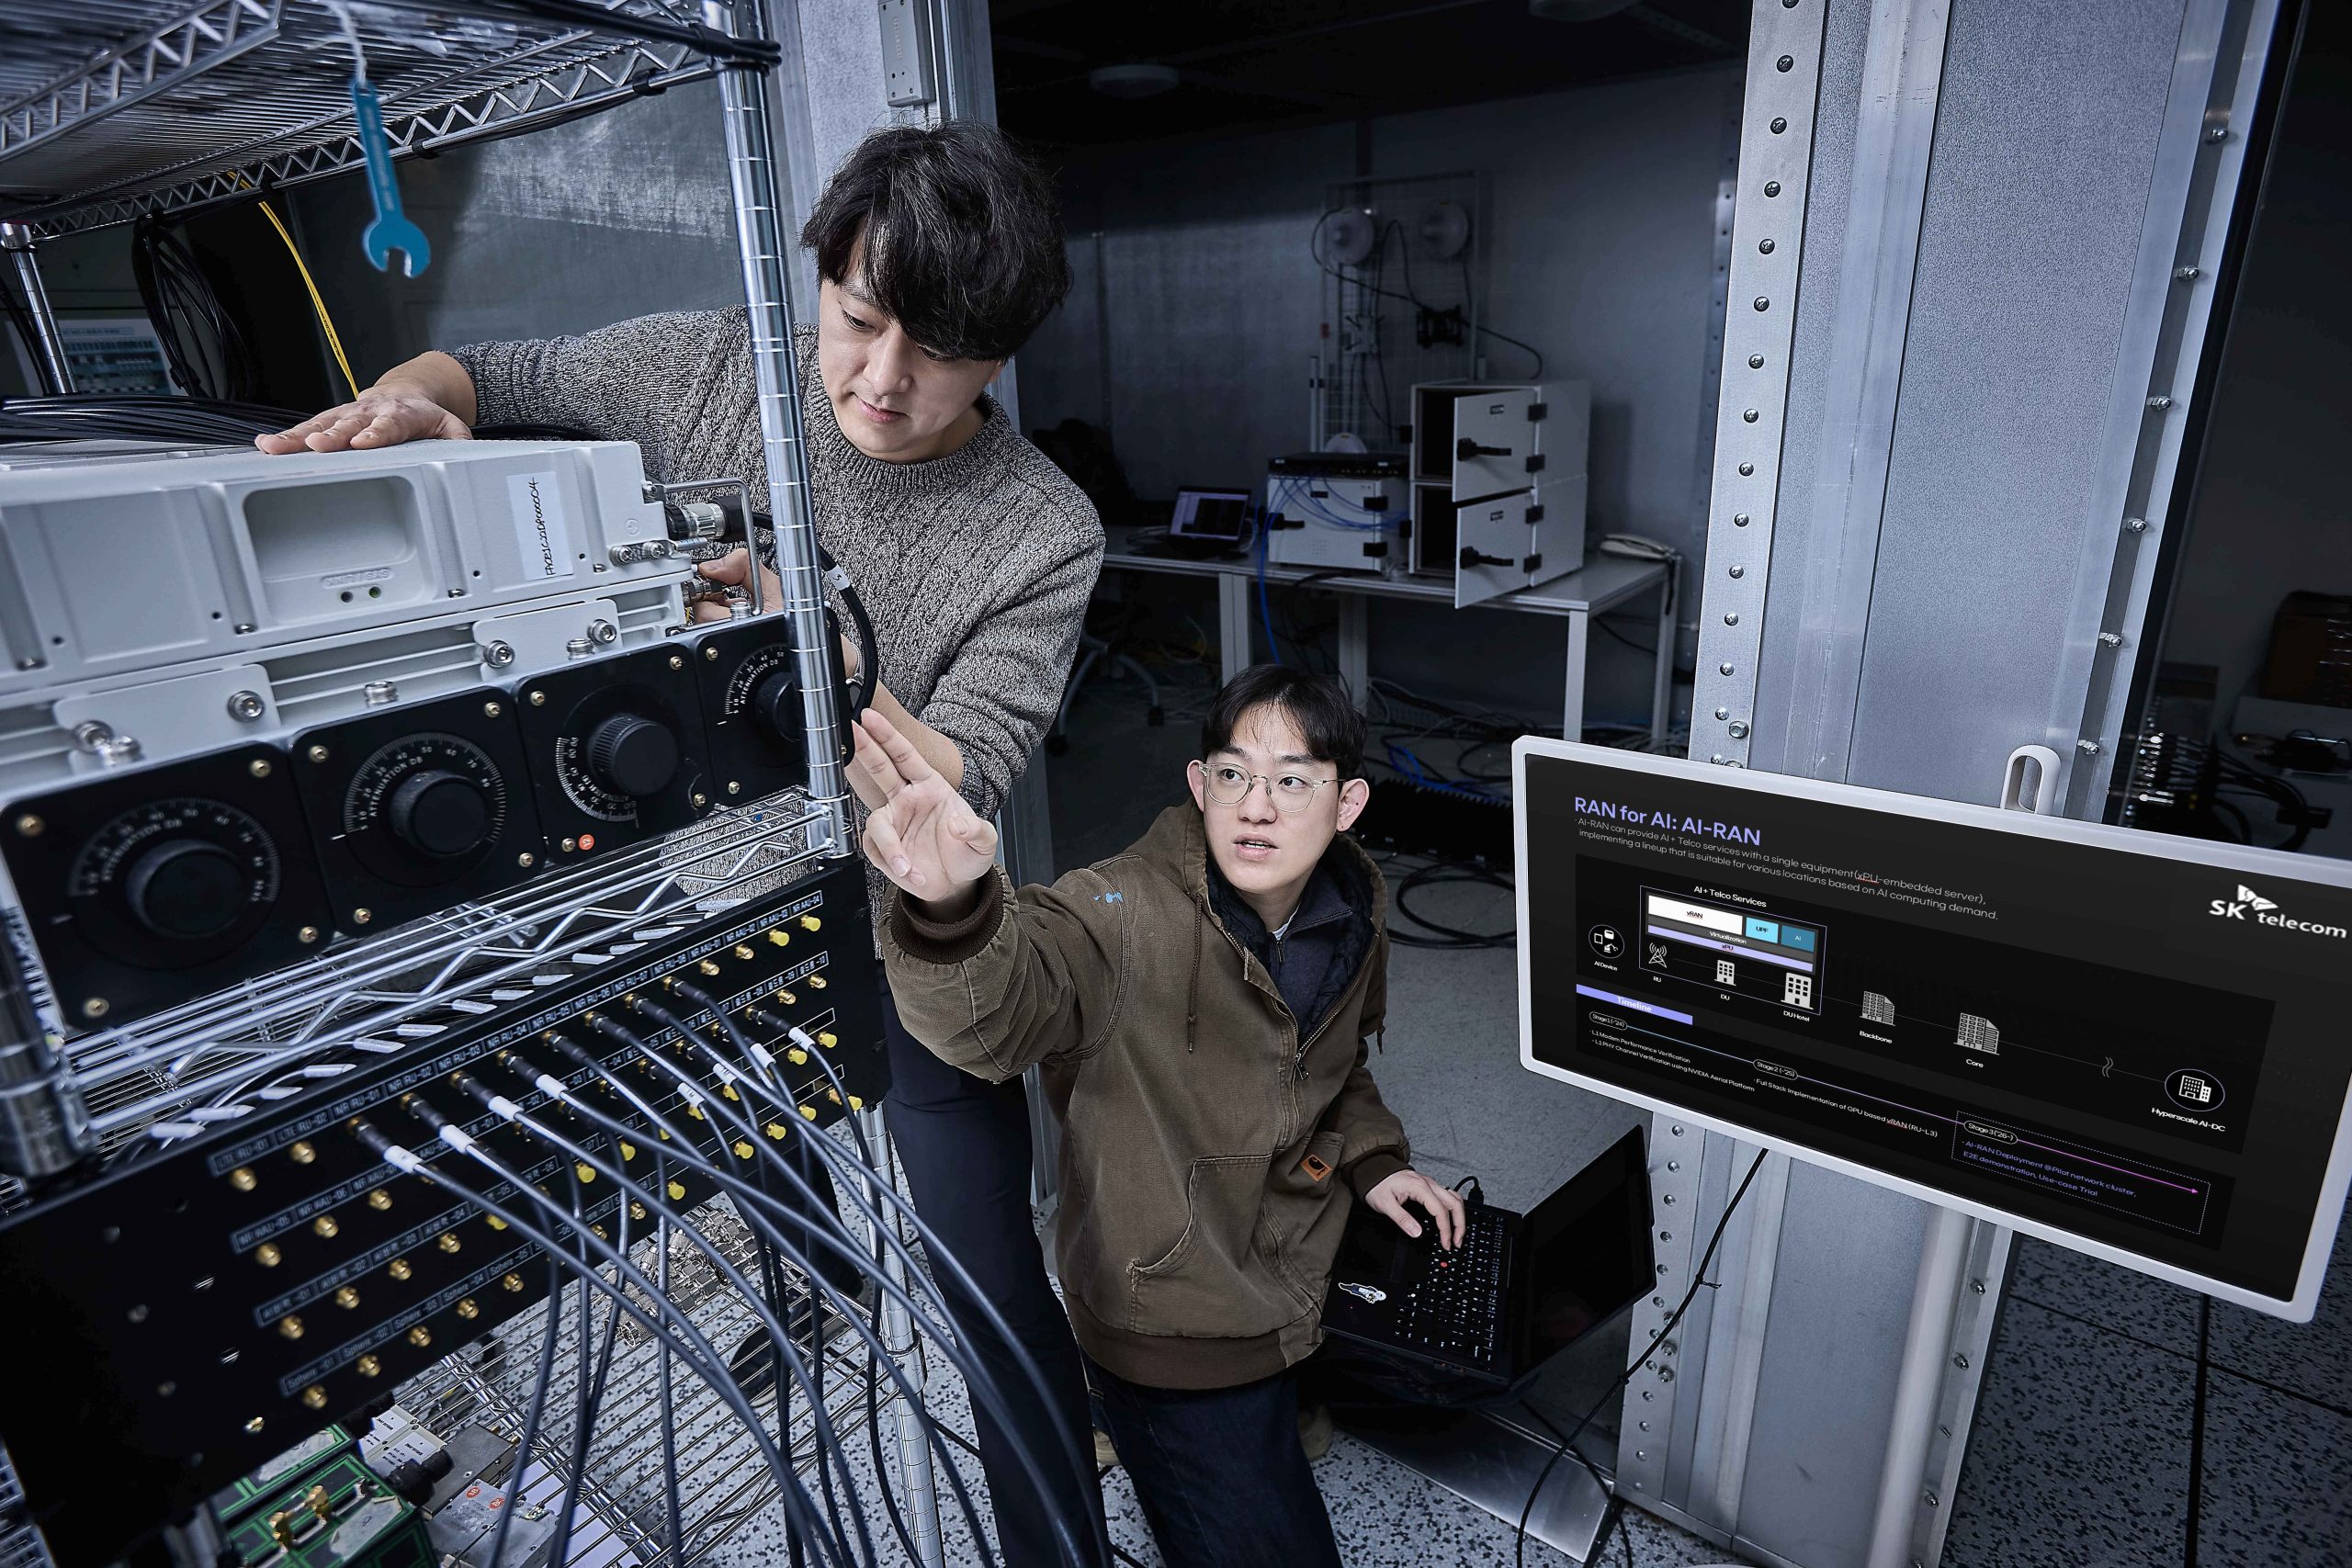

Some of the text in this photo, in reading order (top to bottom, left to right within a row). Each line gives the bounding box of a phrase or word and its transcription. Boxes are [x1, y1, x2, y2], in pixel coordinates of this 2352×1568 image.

[740, 662, 769, 705] ATTENUATION
[421, 746, 434, 754] 50
[368, 761, 408, 818] ATTENUATION
[1575, 796, 1760, 846] RAN for AI: AI-RAN
[1577, 818, 1609, 830] AI-RAN
[1611, 825, 1626, 833] can
[1628, 828, 1659, 840] provide
[1660, 832, 1669, 842] AI
[1678, 836, 1702, 848] Telco
[1702, 843, 1741, 856] services
[1741, 850, 1762, 861] with
[1771, 854, 1799, 868] single
[1944, 889, 1986, 906] server),
[1579, 829, 1634, 848] implementing
[1642, 841, 1668, 855] lineup
[1668, 847, 1687, 857] that
[1688, 850, 1695, 859] is
[1696, 852, 1732, 866] suitable
[1733, 858, 1747, 869] for
[1747, 863, 1781, 876] various
[1782, 870, 1826, 886] locations
[1828, 878, 1860, 892] based
[1861, 886, 1875, 896] on
[1877, 888, 1888, 897] AI
[1889, 891, 1947, 911] computing
[1949, 903, 1998, 920] demand.
[1693, 886, 1702, 894] AI
[1709, 888, 1731, 900] Telco
[1732, 894, 1767, 908] Services
[1686, 910, 1703, 919] vRAN
[2208, 899, 2347, 939] SK telecom
[1709, 931, 1747, 944] Virtualization
[1601, 963, 1618, 972] Device
[1617, 996, 1652, 1012] Timeline
[1592, 1014, 1607, 1022] Stage
[1783, 1010, 1811, 1022] DU Hotel
[1860, 1031, 1893, 1044] Backbone
[1600, 1032, 1620, 1043] Modem
[1621, 1037, 1657, 1054] Performance
[1657, 1049, 1690, 1064] Verification
[438, 1057, 453, 1069] NR
[1615, 1045, 1639, 1057] Channel
[1639, 1052, 1671, 1067] Verification
[1671, 1063, 1688, 1073] using
[1688, 1066, 1709, 1078] NVIDIA
[1710, 1074, 1728, 1085] Aerial
[1728, 1078, 1755, 1092] Platform
[1757, 1061, 1774, 1072] Stage
[1965, 1058, 1984, 1068] Core
[388, 1079, 403, 1090] NR
[334, 1102, 350, 1115] NR
[1756, 1078, 1767, 1087] Full
[1768, 1082, 1787, 1092] Stack
[1787, 1087, 1838, 1108] Implementation
[1839, 1102, 1847, 1111] of
[1848, 1105, 1863, 1115] GPU
[1864, 1110, 1886, 1122] based
[1886, 1118, 1908, 1129] vRAN
[1968, 1122, 1988, 1134] Stage
[2152, 1107, 2226, 1133] Hyperscale AI-DC
[1963, 1150, 2098, 1197] E2E demonstration, Use-case Trial
[1965, 1140, 2137, 1198] AI-RAN Deployment @Pilot network cluster,
[490, 1258, 514, 1275] Sphere
[445, 1283, 470, 1301] Sphere
